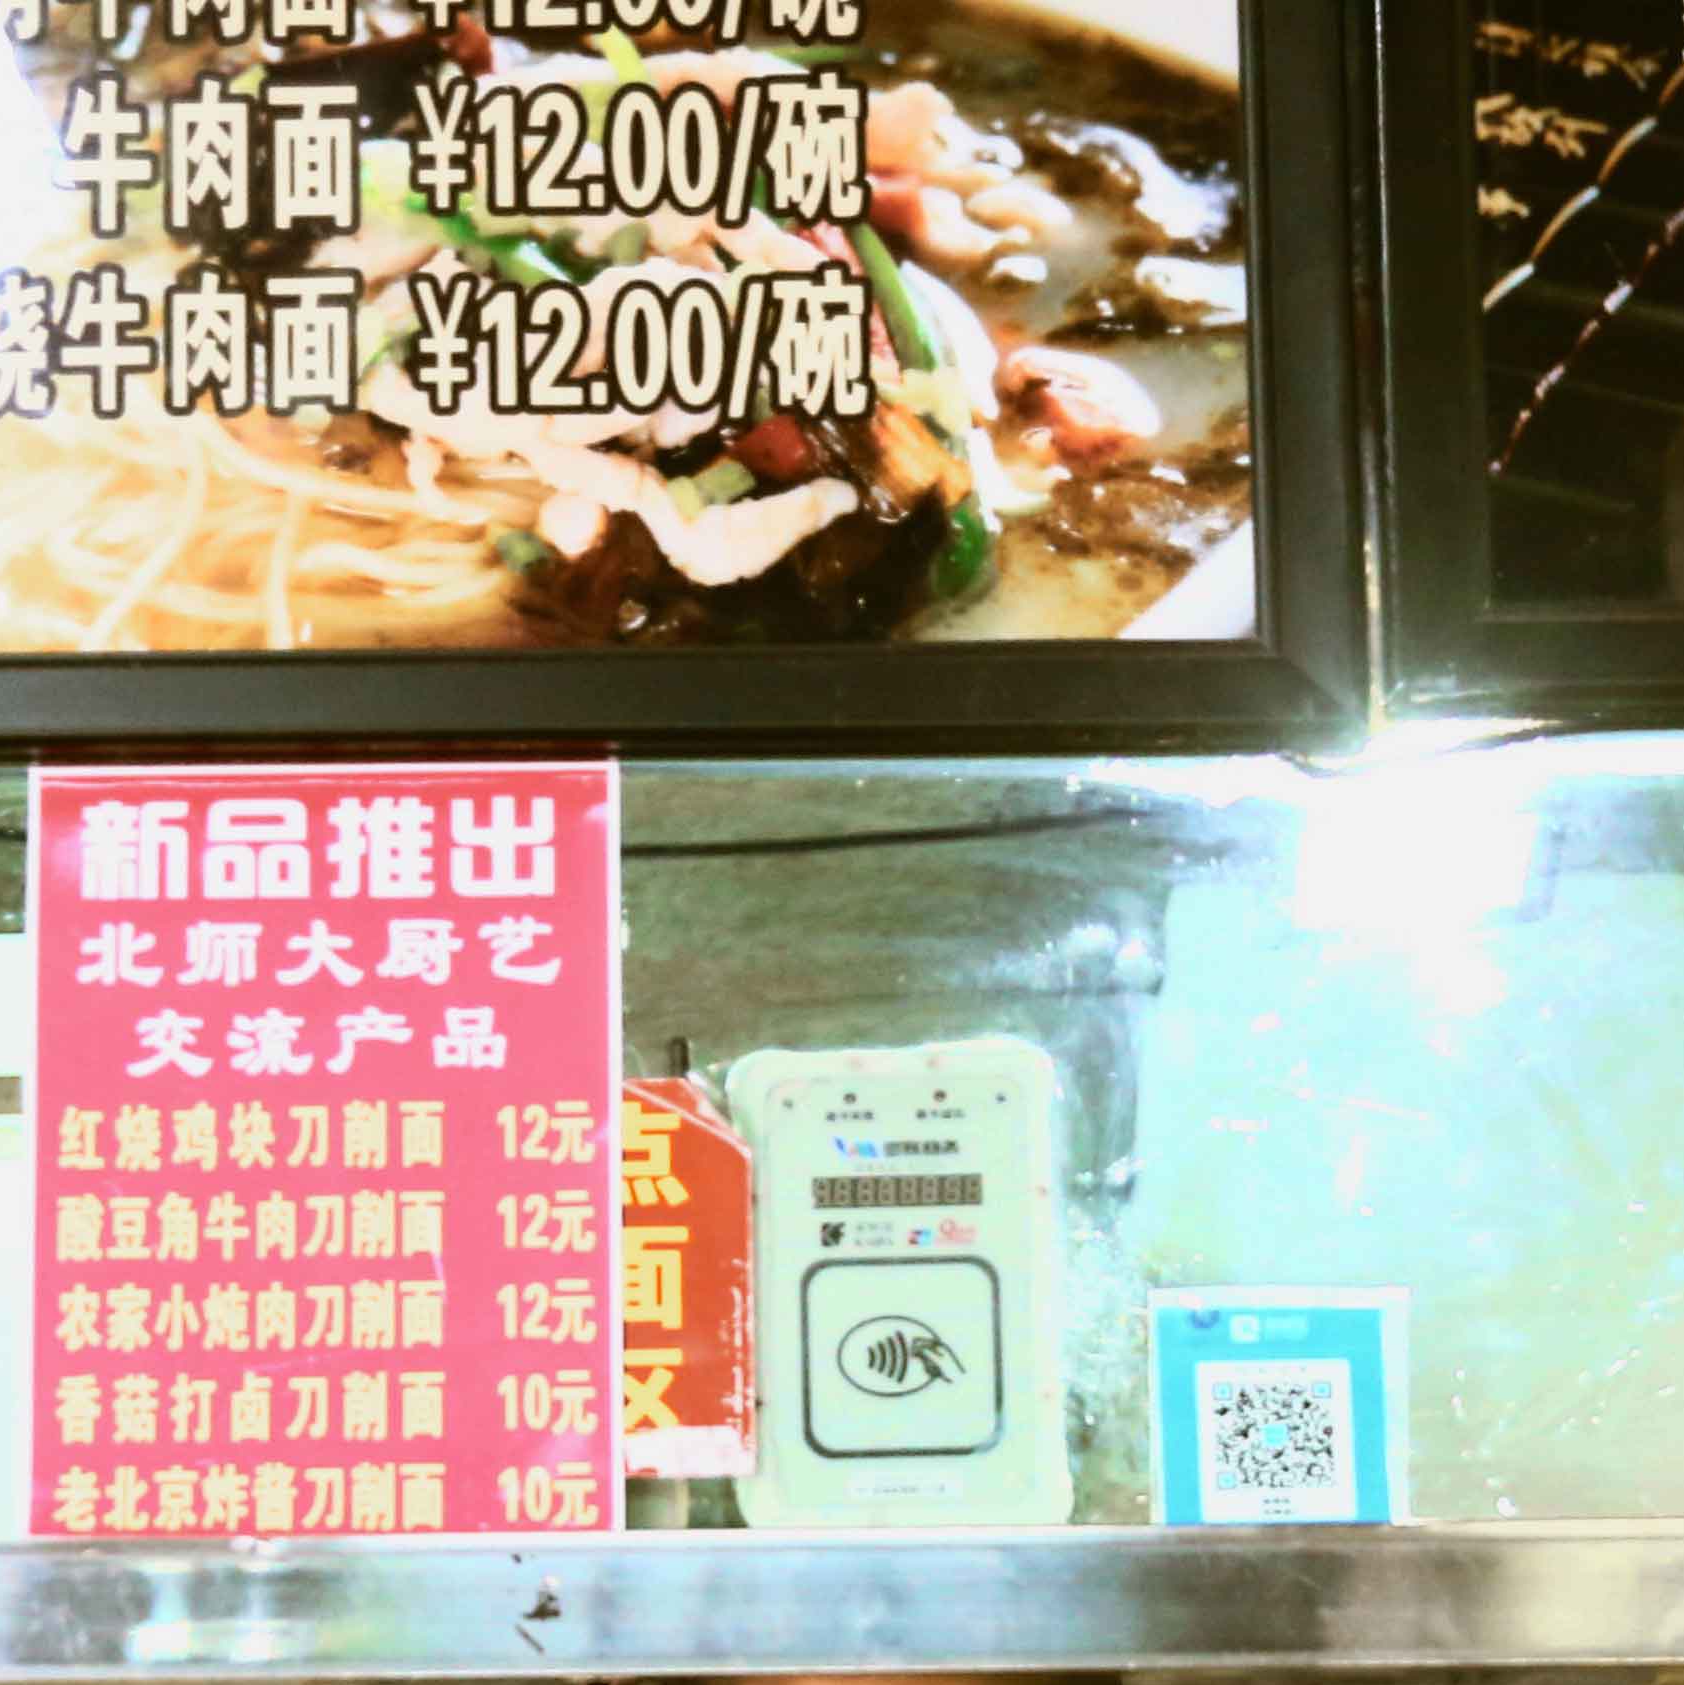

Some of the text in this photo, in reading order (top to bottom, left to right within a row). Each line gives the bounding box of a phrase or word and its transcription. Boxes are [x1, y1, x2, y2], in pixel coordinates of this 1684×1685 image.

[416, 72, 865, 219] ¥12.00/碗
[416, 264, 871, 412] ¥12.00/碗
[79, 797, 554, 899] 新品推出
[78, 917, 560, 986] 北师大厨艺
[128, 1007, 506, 1076] 交流产品
[59, 1101, 595, 1170] 红烧鸡块刀削面 12元
[57, 1190, 596, 1260] 酸豆角牛肉刀削面 12元
[57, 1279, 596, 1352] 农家小炖肉刀削面 12元
[56, 1370, 597, 1443] 香菇打卤刀削面 10元
[54, 1462, 598, 1530] 老北京炸酱刀削面 10元
